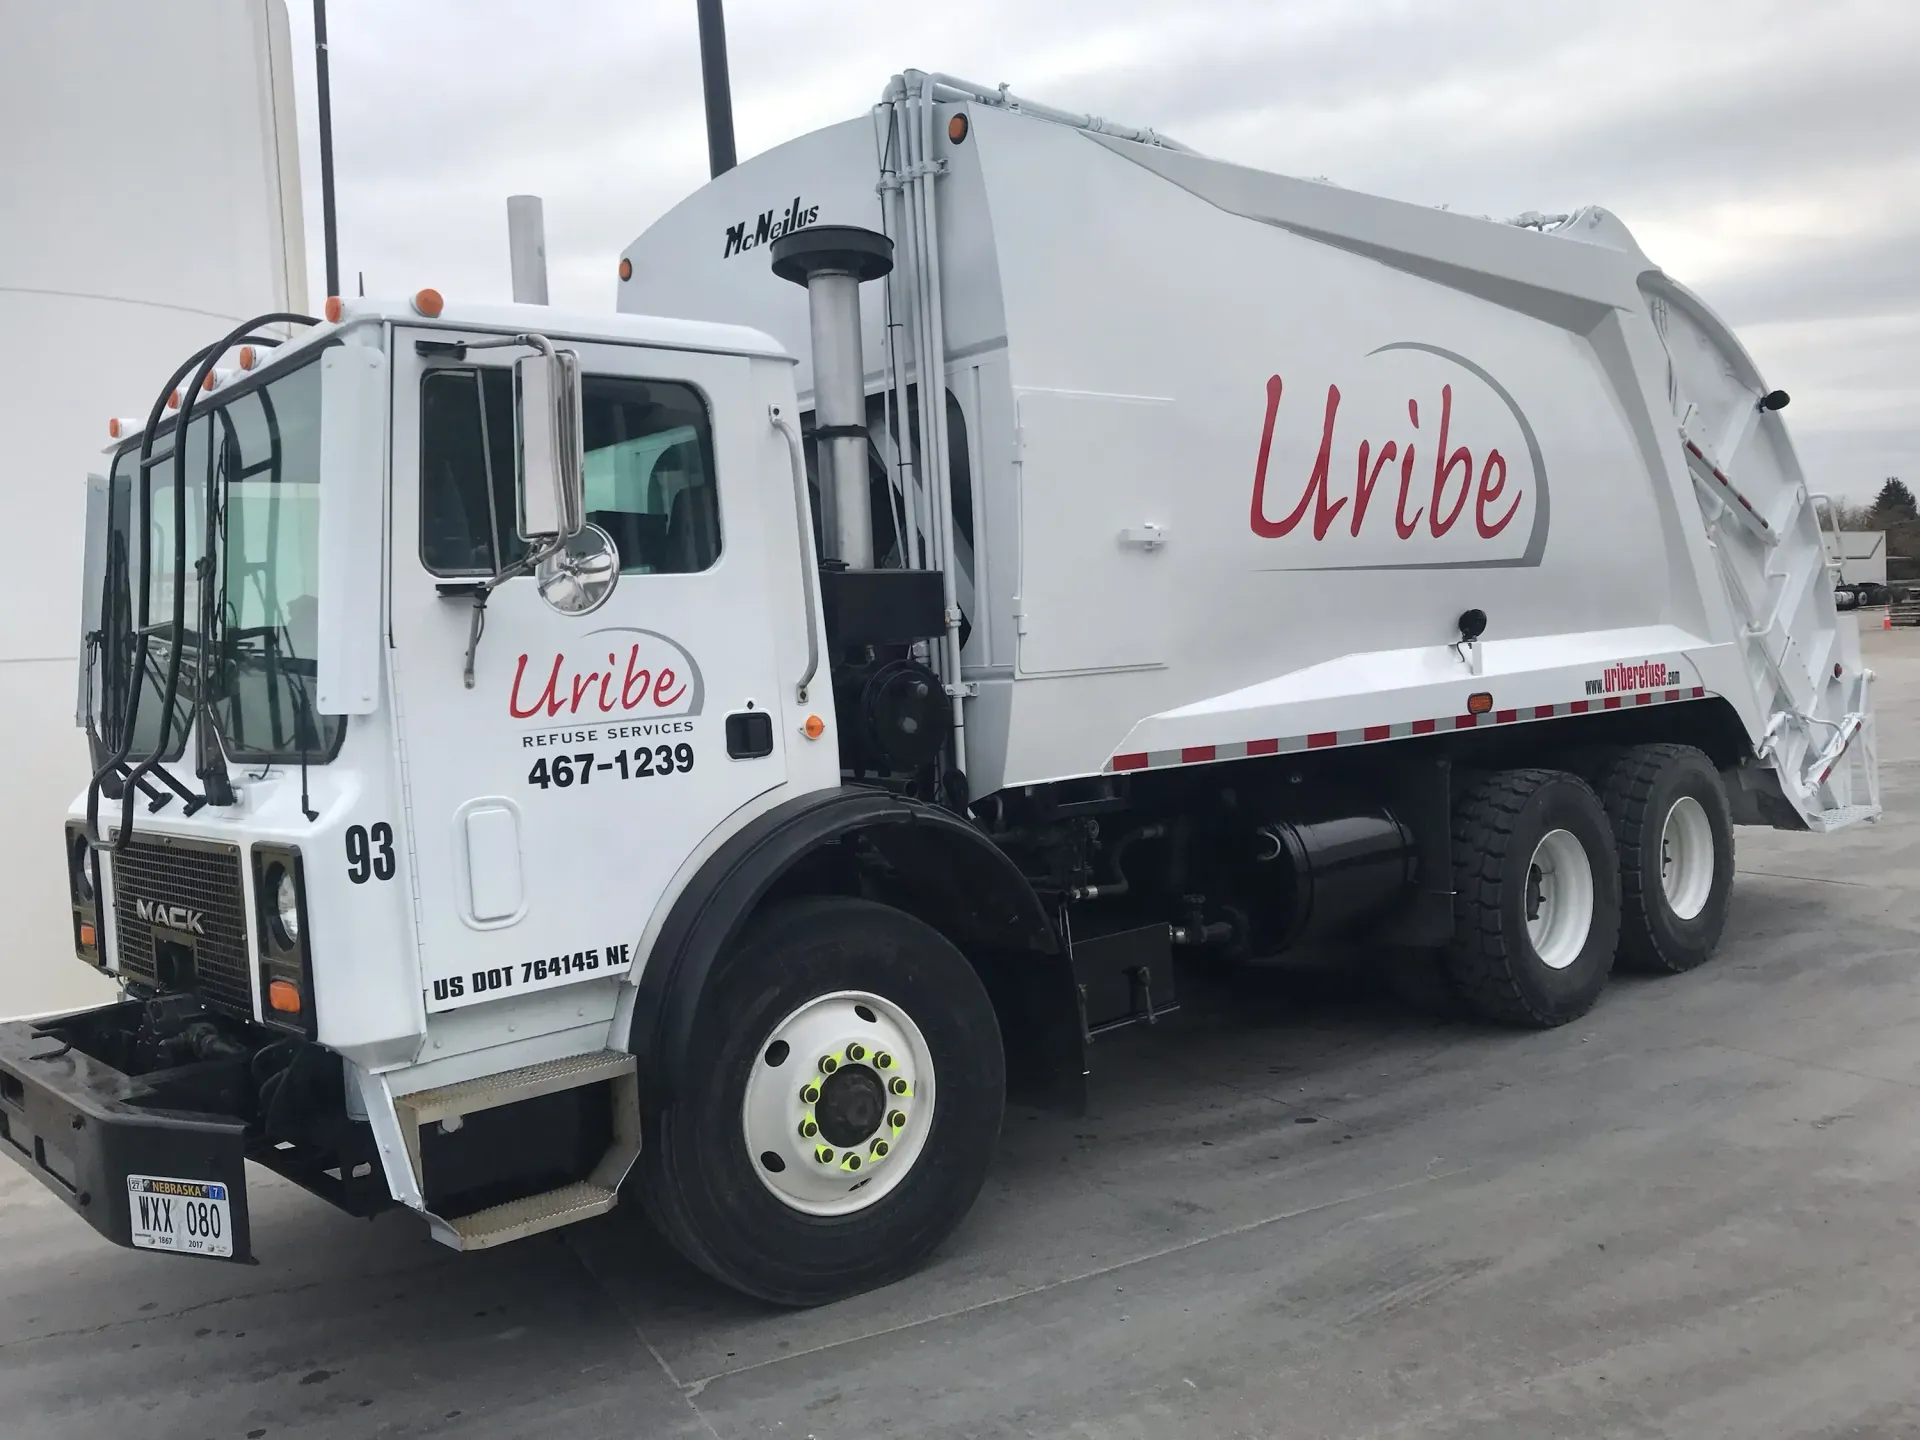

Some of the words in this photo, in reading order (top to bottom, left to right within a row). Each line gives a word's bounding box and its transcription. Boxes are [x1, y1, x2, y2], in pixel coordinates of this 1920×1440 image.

[724, 196, 819, 259] McNeilus
[1250, 374, 1523, 541] Uribe
[509, 643, 687, 719] Uribe
[1585, 660, 1680, 695] www.uriberefuse.com
[522, 730, 598, 748] REFUSE
[607, 721, 694, 739] SERVICES
[528, 743, 694, 789] 467-1239
[345, 822, 396, 884] 93
[136, 899, 205, 935] MACK
[433, 976, 464, 1000] US
[472, 966, 513, 993] DOT
[521, 949, 599, 983] 764145
[606, 944, 629, 966] NE
[152, 1181, 202, 1196] NEBRASKA
[139, 1196, 173, 1233] WXX
[186, 1201, 221, 1238] 080
[158, 1236, 172, 1245] 1867
[188, 1240, 203, 1249] 2017
